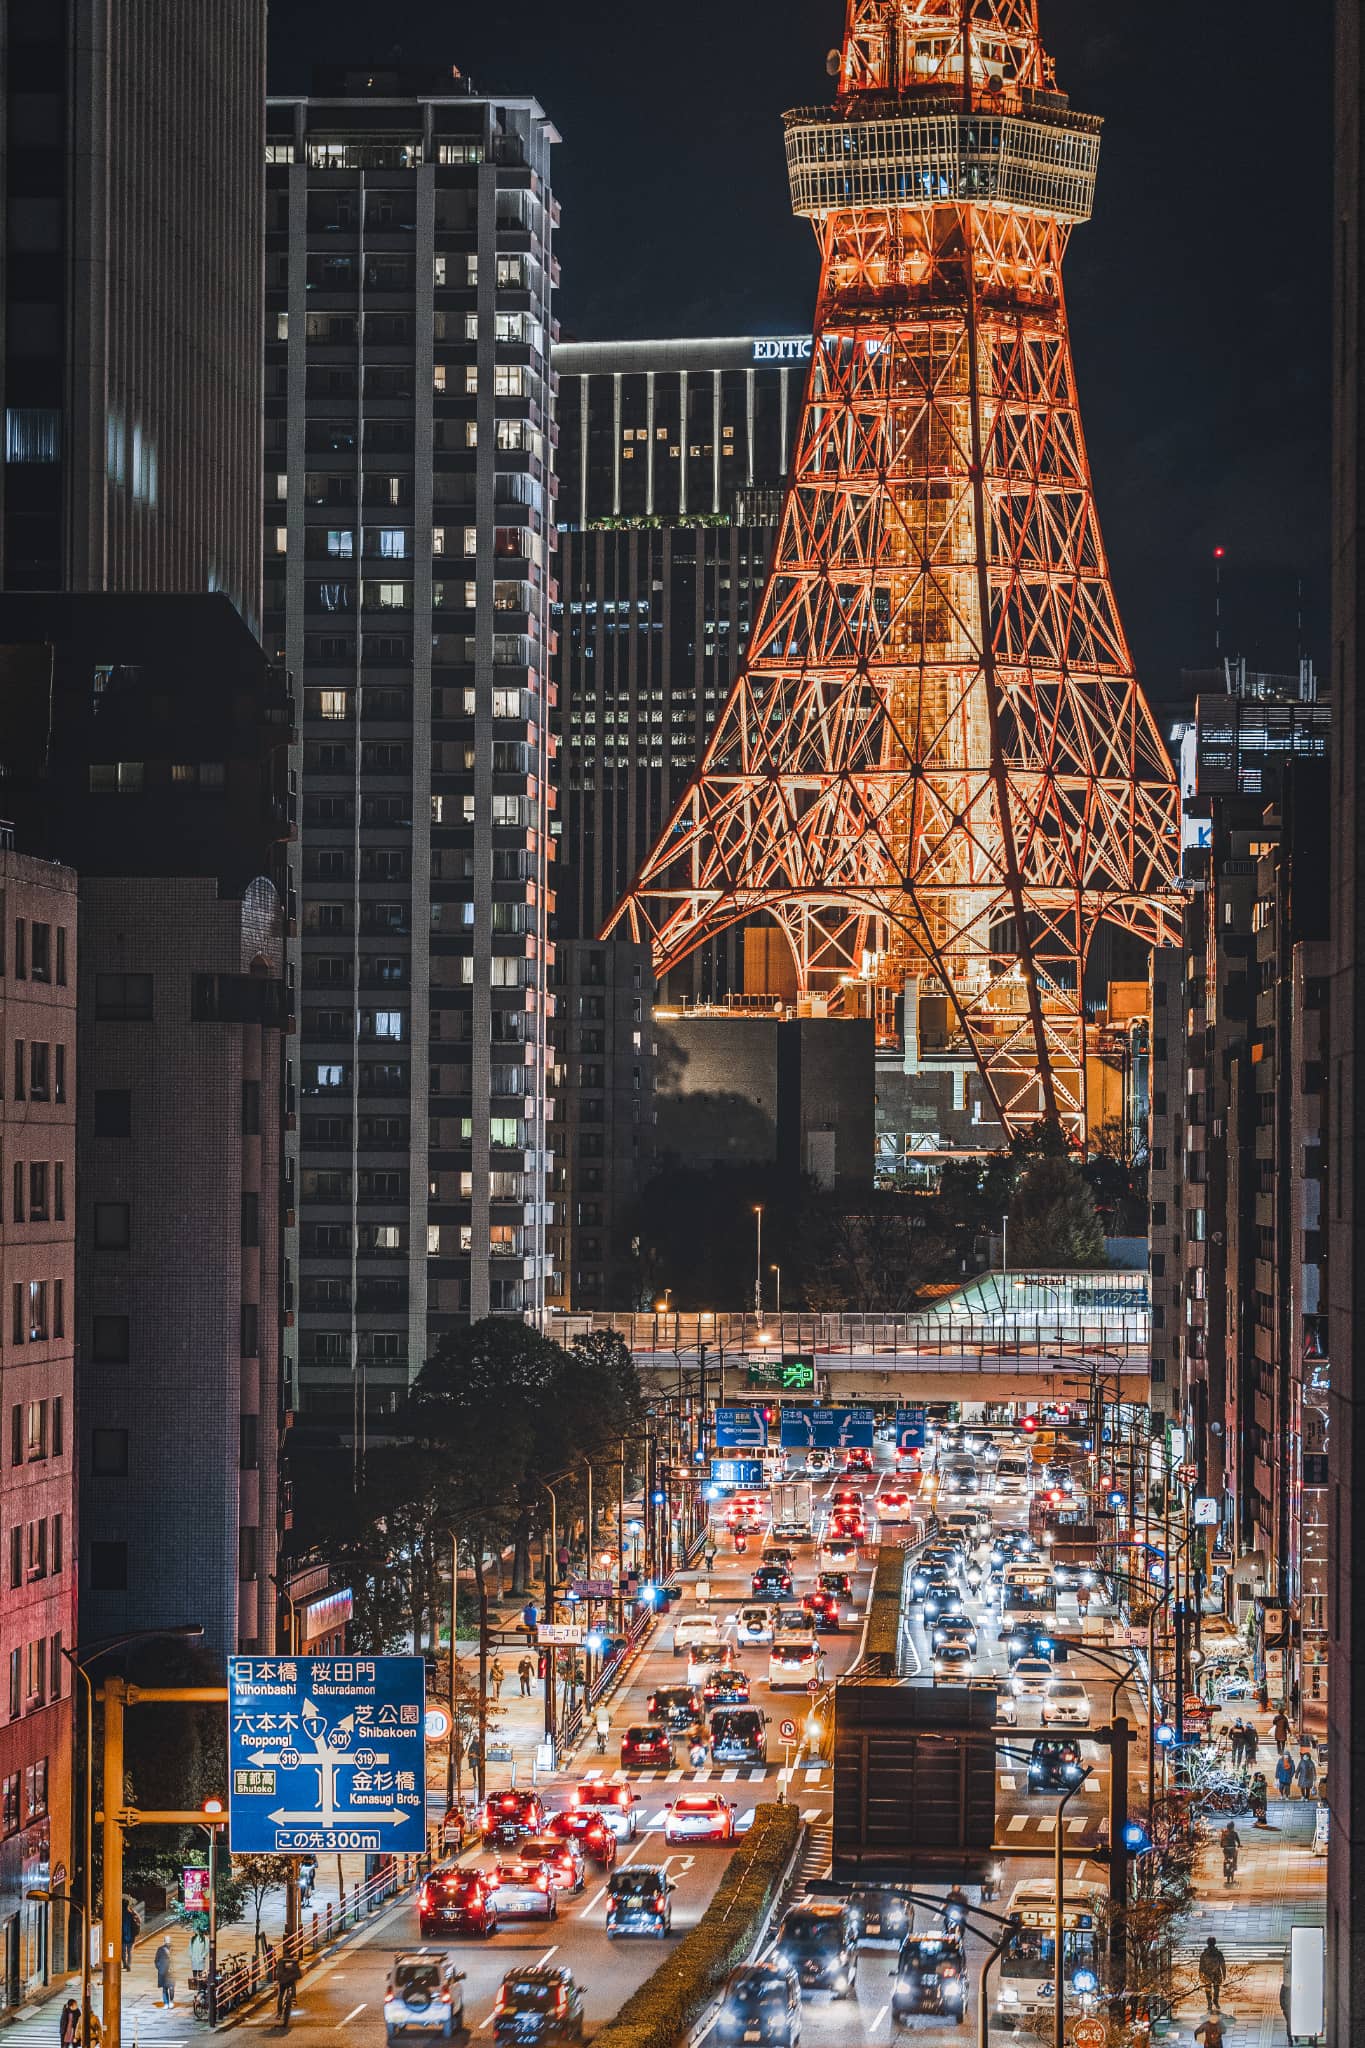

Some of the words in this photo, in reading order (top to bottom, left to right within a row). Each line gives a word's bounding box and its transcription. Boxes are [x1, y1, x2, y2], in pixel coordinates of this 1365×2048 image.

[235, 1661, 298, 1682] 日本橋
[311, 1662, 376, 1682] 桜田門
[235, 1684, 297, 1695] Nihonbashi
[312, 1684, 376, 1695] Sakuradamon
[354, 1704, 420, 1725] 芝公園
[234, 1712, 299, 1733] 六本木
[310, 1720, 317, 1733] 1
[358, 1726, 417, 1738] Shibakoen
[241, 1734, 292, 1747] Roppongi
[331, 1734, 348, 1744] 301
[281, 1754, 297, 1764] 319
[357, 1754, 373, 1764] 319
[236, 1772, 274, 1785] 首都高
[352, 1771, 416, 1791] 金杉橋
[237, 1785, 273, 1793] Shutoko
[349, 1793, 394, 1806] Kanasugi
[397, 1793, 421, 1806] Brdg.
[278, 1832, 378, 1848] この先300m
